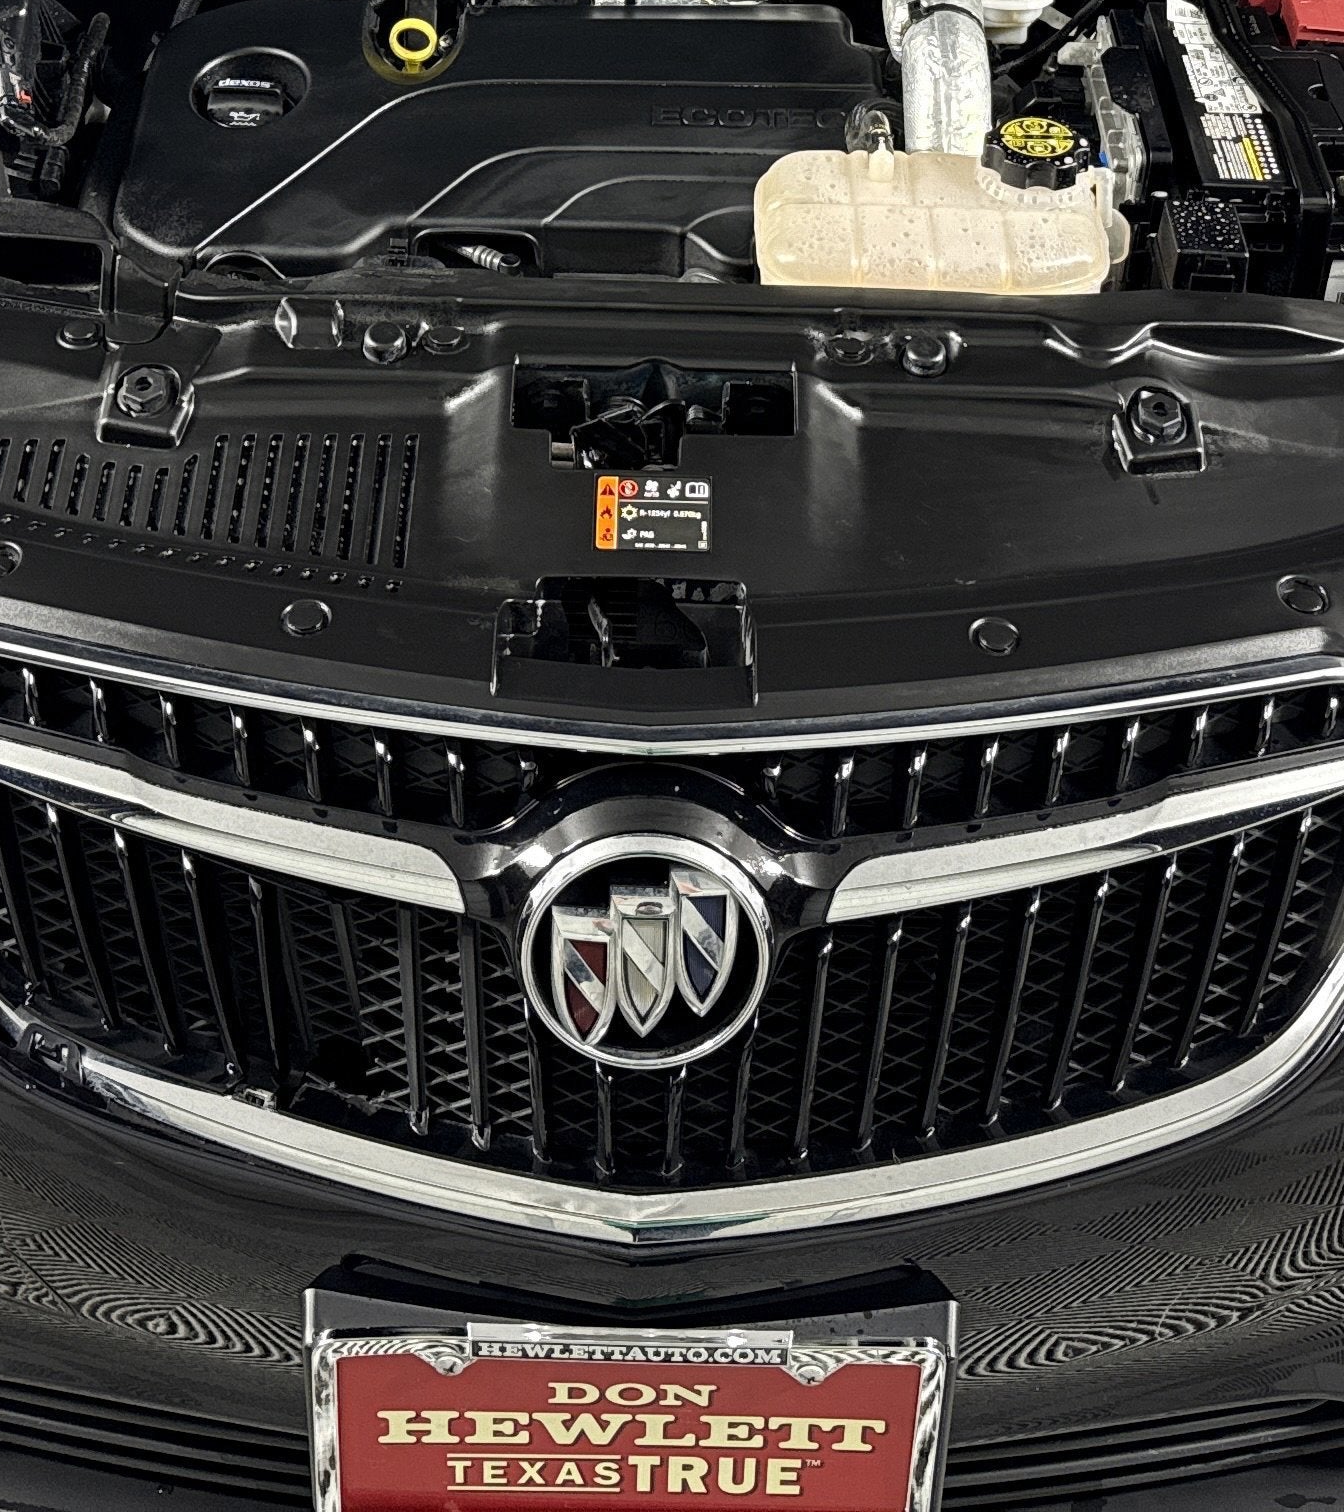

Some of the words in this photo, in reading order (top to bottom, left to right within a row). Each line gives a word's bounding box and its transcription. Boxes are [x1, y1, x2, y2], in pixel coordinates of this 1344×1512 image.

[218, 77, 272, 89] dexos
[650, 104, 846, 128] ECOTEC
[478, 1342, 782, 1364] HEWLETTAUTO.COM
[548, 1382, 718, 1407] DON
[377, 1410, 887, 1453] HEWLETT
